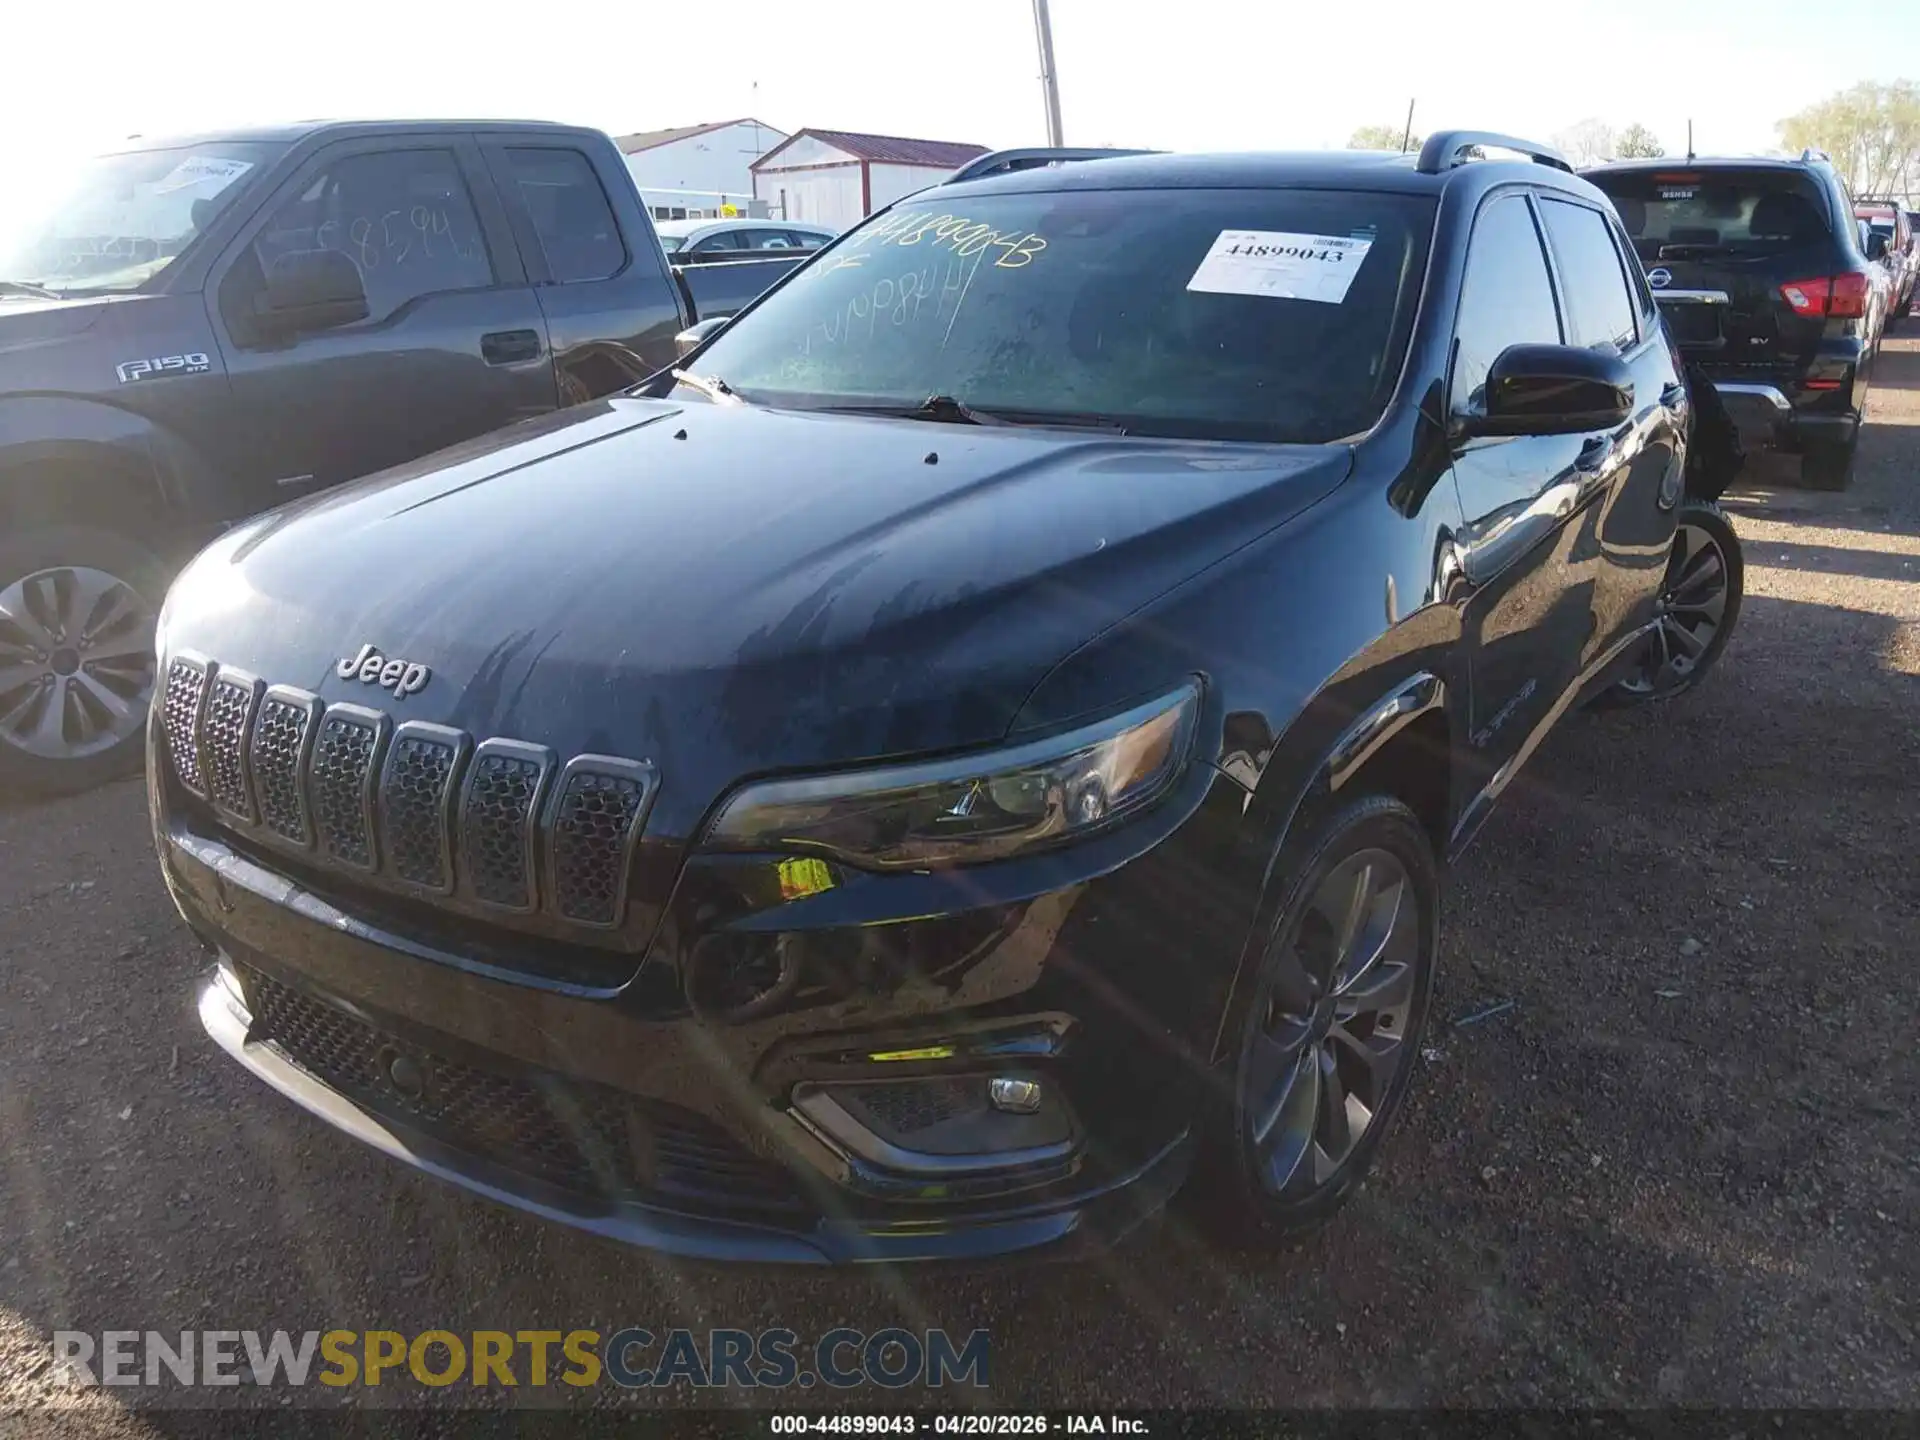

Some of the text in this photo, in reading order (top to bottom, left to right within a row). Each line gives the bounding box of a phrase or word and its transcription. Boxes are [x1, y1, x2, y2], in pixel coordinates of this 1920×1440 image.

[1225, 243, 1344, 264] 44899043
[1750, 337, 1769, 345] SV
[337, 643, 432, 701] Jeep
